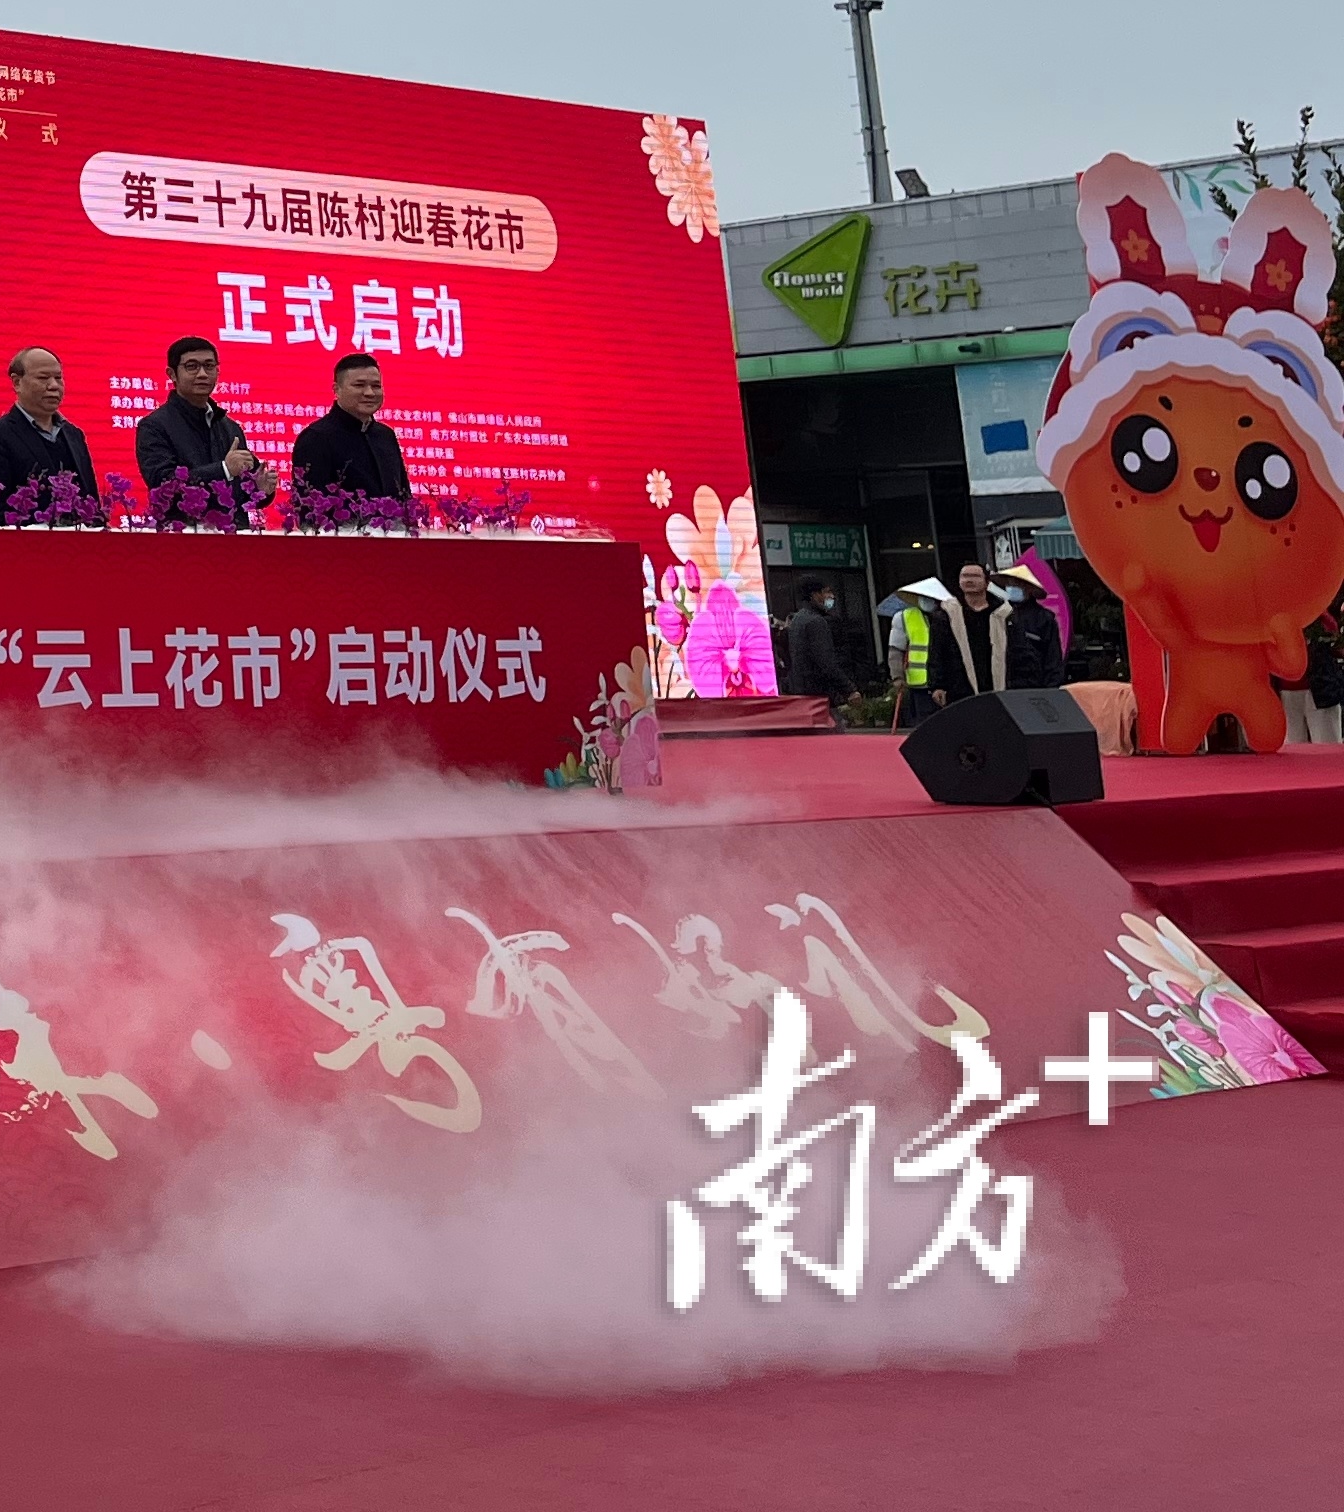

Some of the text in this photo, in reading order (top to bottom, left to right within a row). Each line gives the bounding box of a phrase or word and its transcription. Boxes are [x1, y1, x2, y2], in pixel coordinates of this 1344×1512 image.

[120, 169, 525, 254] 第三十九届陈村迎春花市
[216, 271, 464, 358] 正式启动
[881, 260, 981, 317] 花卉
